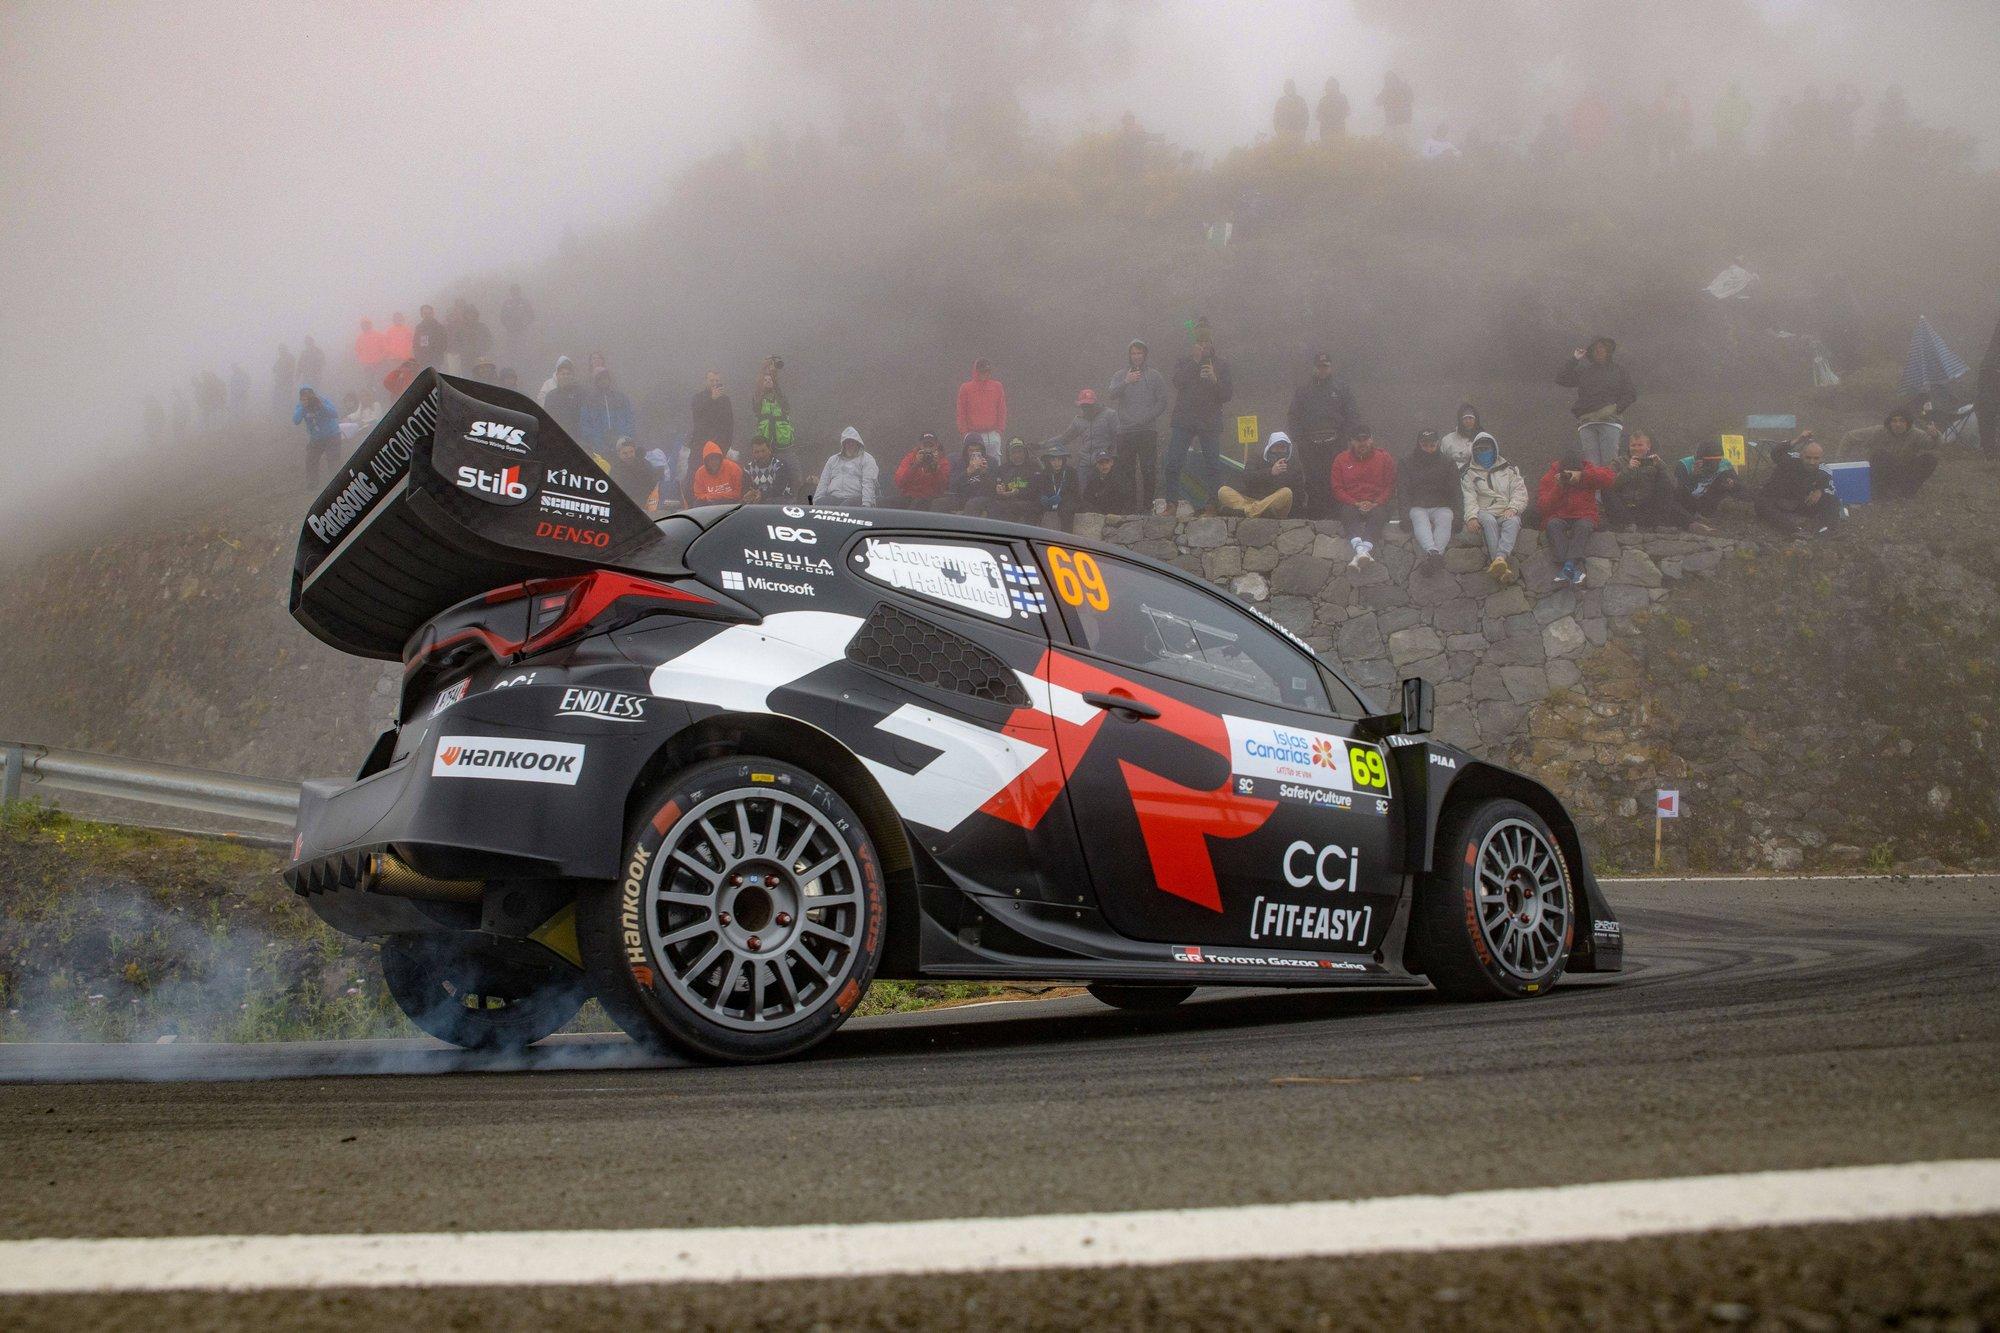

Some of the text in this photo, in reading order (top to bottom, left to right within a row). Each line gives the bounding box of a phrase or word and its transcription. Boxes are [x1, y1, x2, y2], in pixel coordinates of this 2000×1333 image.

[470, 421, 528, 446] SWS
[456, 465, 527, 499] Stilo
[308, 467, 378, 545] Panasonic
[540, 495, 610, 518] SCHROTH
[540, 507, 610, 524] RACING
[809, 509, 850, 518] JAPAN
[813, 514, 873, 527] AIRLINES
[536, 521, 610, 547] DENSO
[744, 548, 832, 570] NISULA
[747, 576, 815, 596] Microsoft
[1047, 545, 1110, 611] 69
[559, 688, 648, 718] ENDLESS
[1273, 730, 1309, 749] Islas
[1245, 739, 1311, 766] Canarias
[1430, 753, 1456, 769] PIAA
[1349, 747, 1387, 788] 69
[1239, 778, 1253, 791] SC
[1280, 784, 1352, 805] SafetyCulture
[1376, 800, 1388, 812] SC
[1283, 840, 1359, 893] CCi
[1205, 954, 1267, 966] TOYOTA
[1267, 957, 1319, 968] GAZOO
[1319, 960, 1367, 971] Racing
